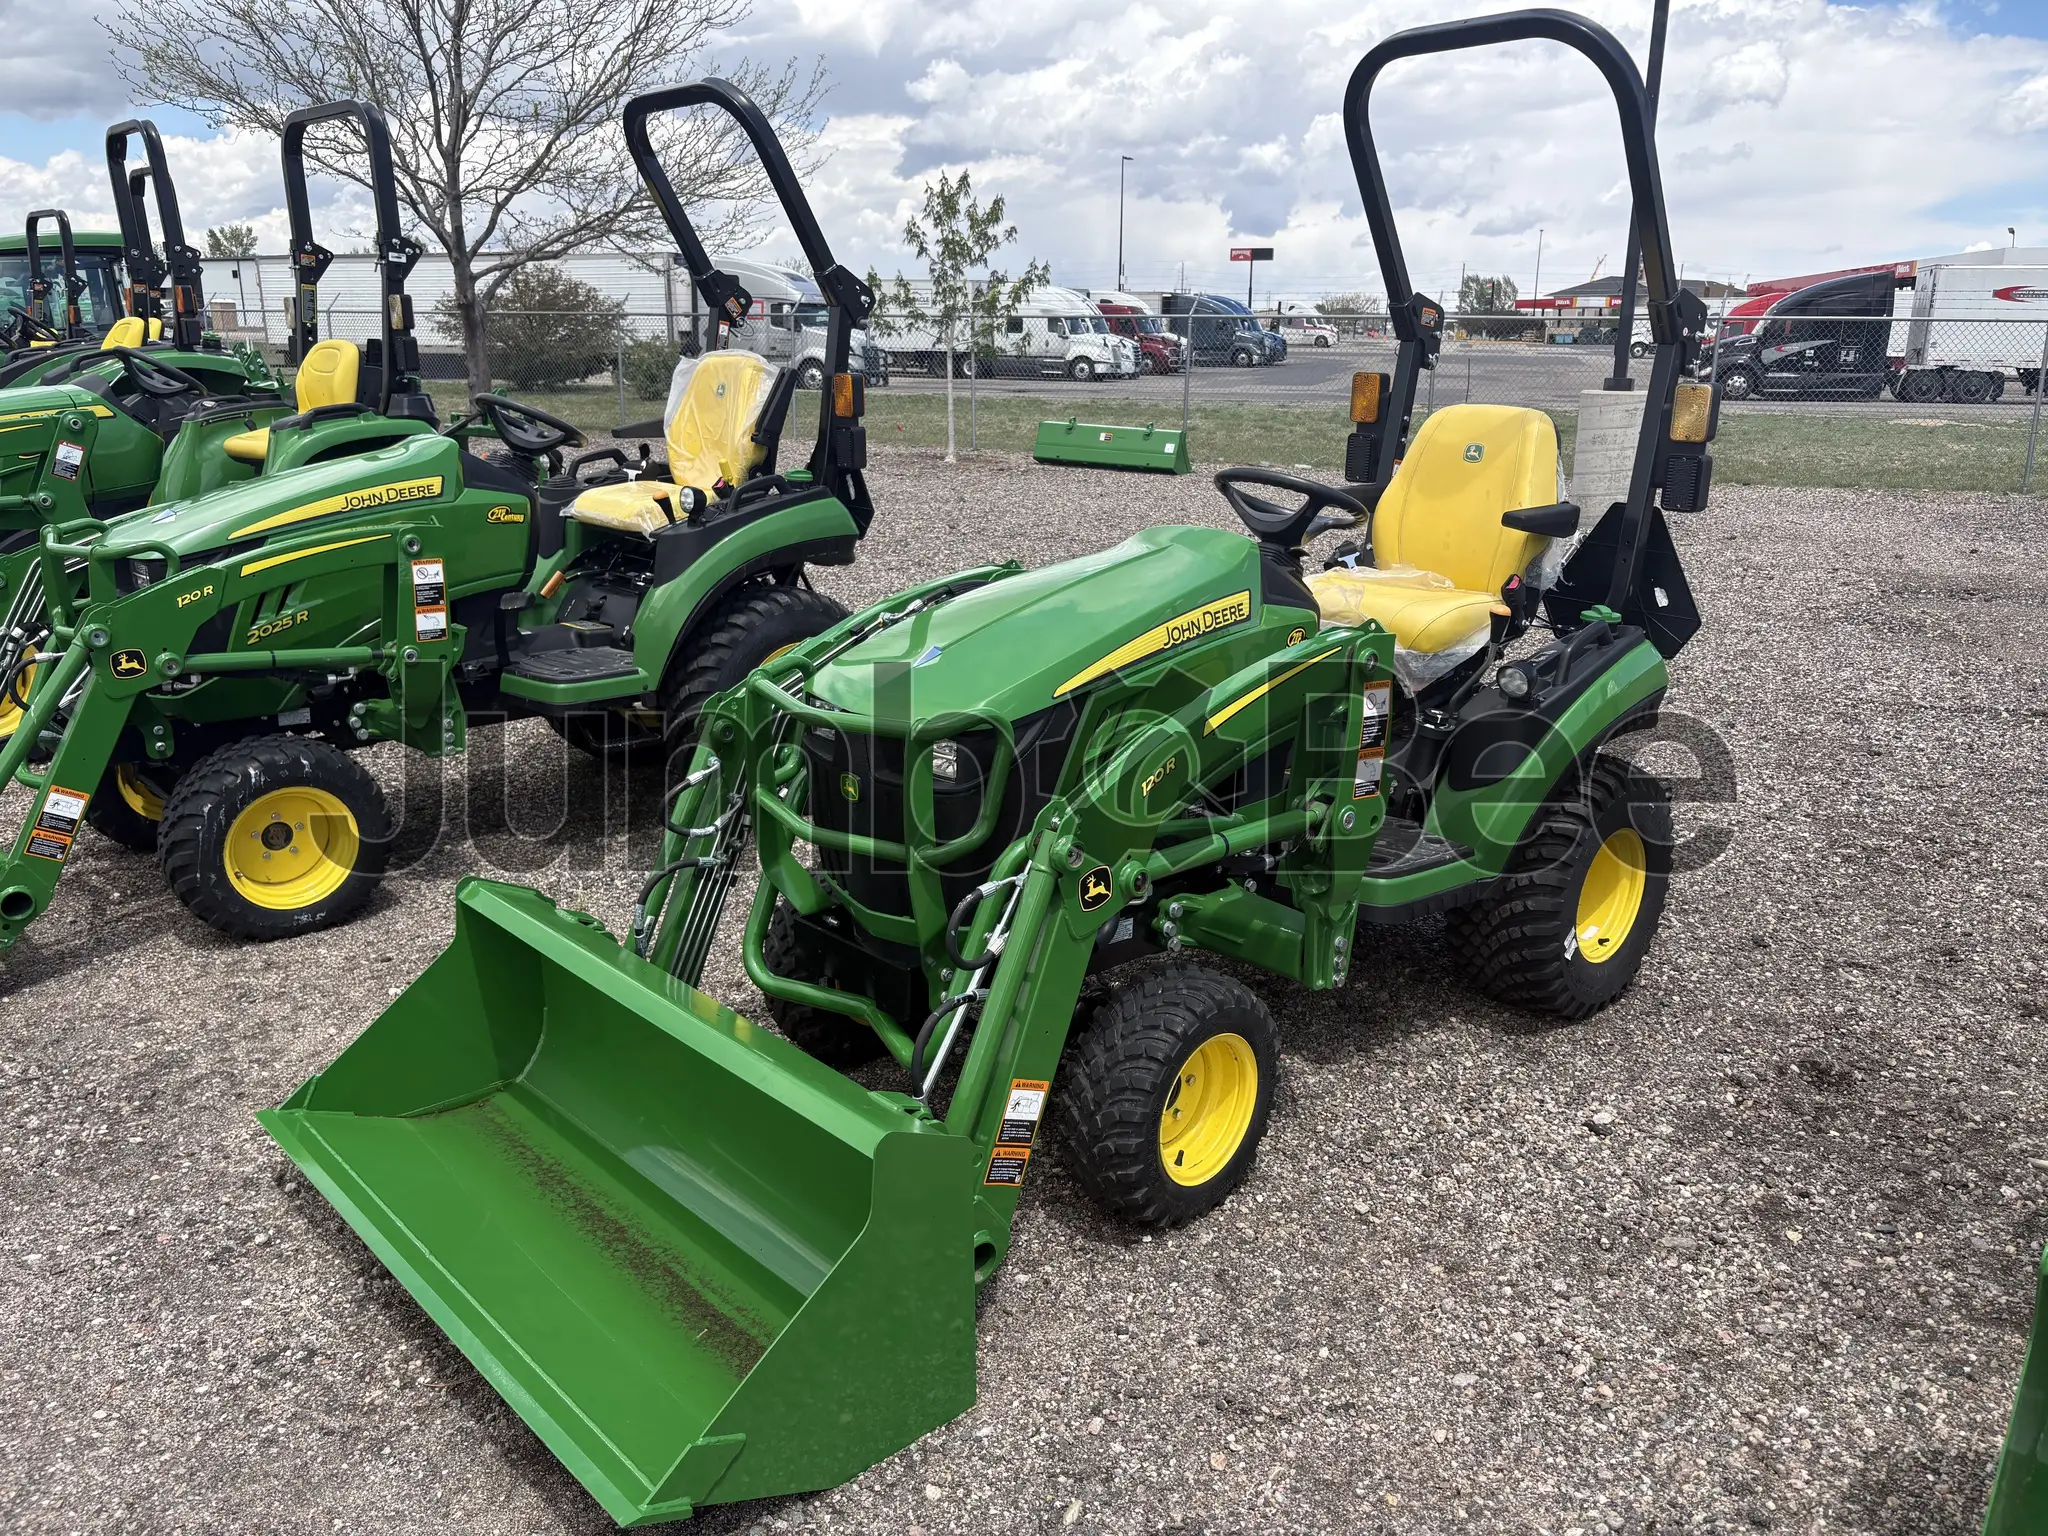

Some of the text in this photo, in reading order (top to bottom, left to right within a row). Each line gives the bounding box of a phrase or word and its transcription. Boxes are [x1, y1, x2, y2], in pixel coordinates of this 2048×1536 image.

[341, 483, 436, 511] JOHN DEERE
[176, 585, 214, 608] 120 R
[247, 610, 309, 645] 2025 R
[1164, 602, 1246, 647] JOHN DEERE
[1368, 681, 1390, 689] WARNING
[1362, 750, 1384, 759] WARNING
[1141, 756, 1176, 797] 120 R
[60, 790, 85, 799] WARNING
[43, 833, 67, 842] WARNING
